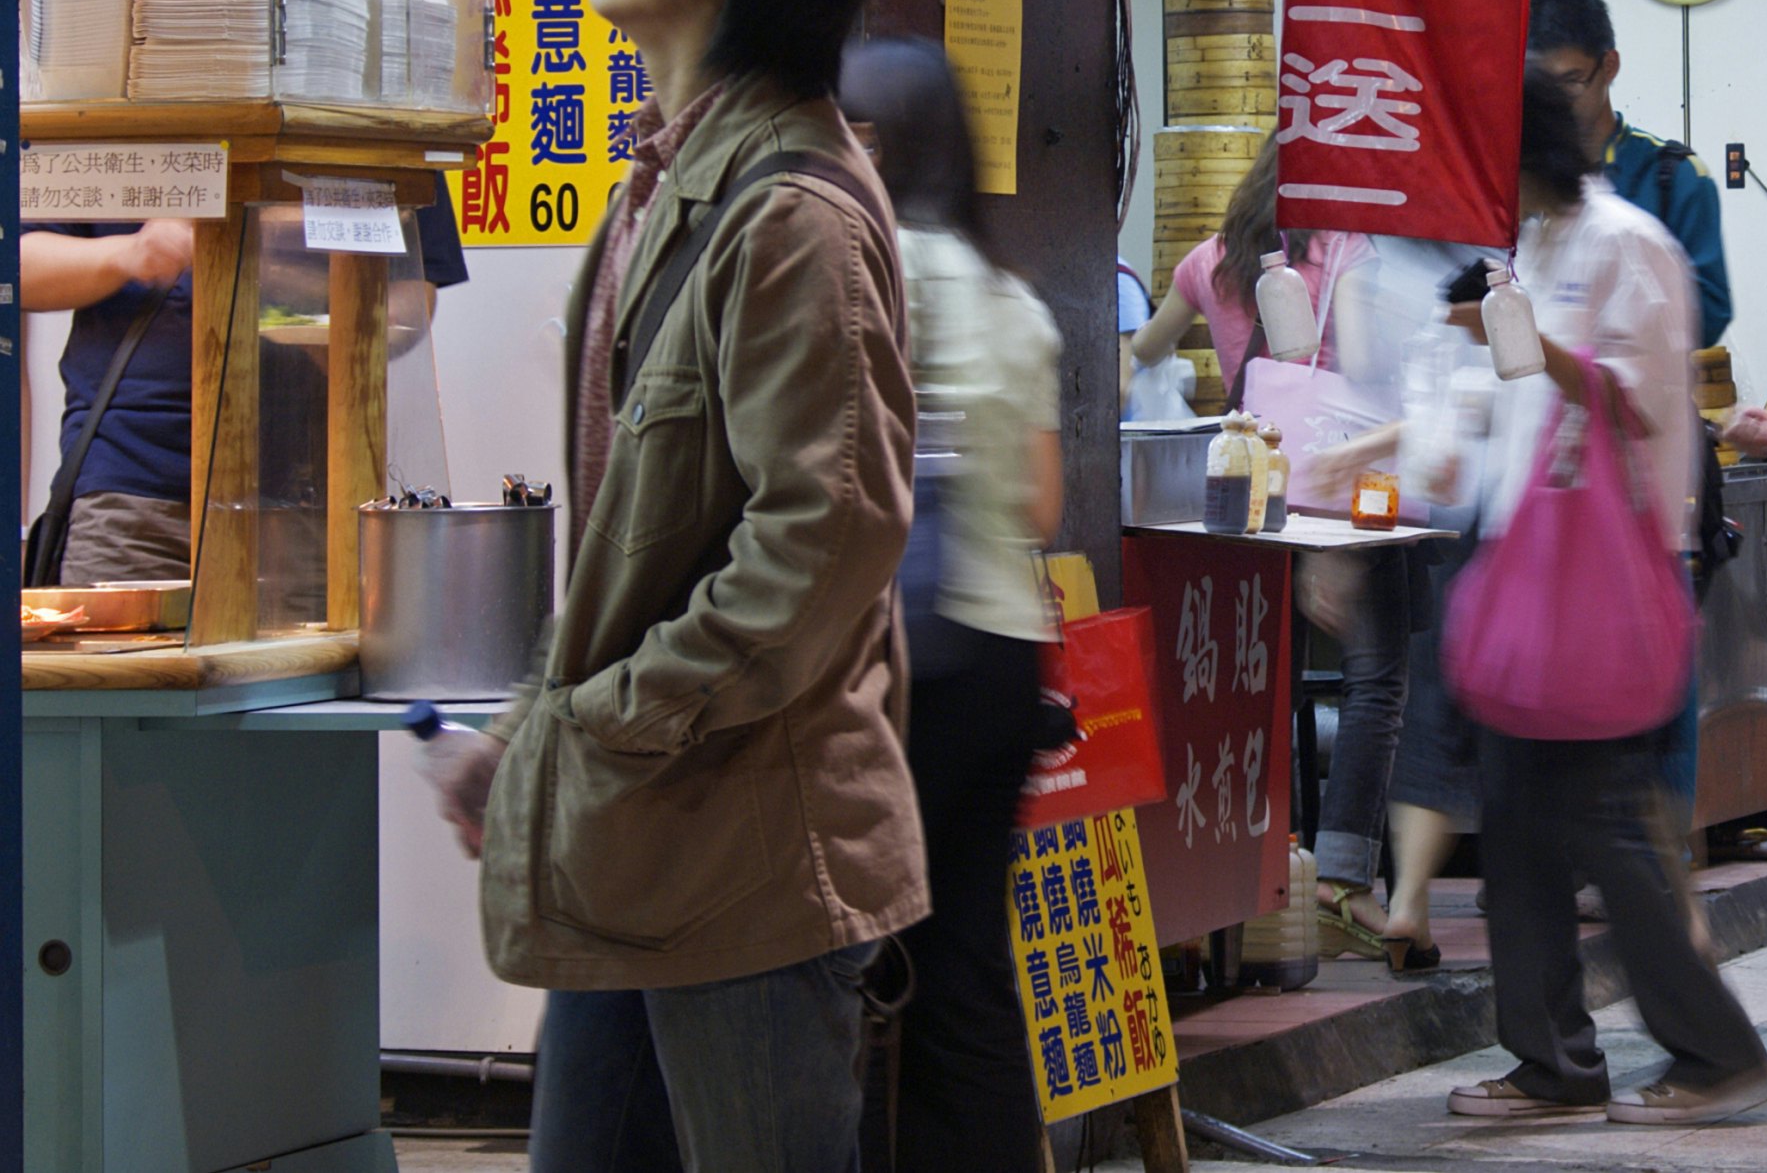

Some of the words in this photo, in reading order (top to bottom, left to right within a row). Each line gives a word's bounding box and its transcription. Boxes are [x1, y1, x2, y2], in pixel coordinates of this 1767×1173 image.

[20, 185, 222, 209] 請勿交談，謝謝合作。
[529, 182, 579, 232] 60
[1176, 573, 1268, 703] 鍋貼
[1176, 727, 1271, 849] 水煎包
